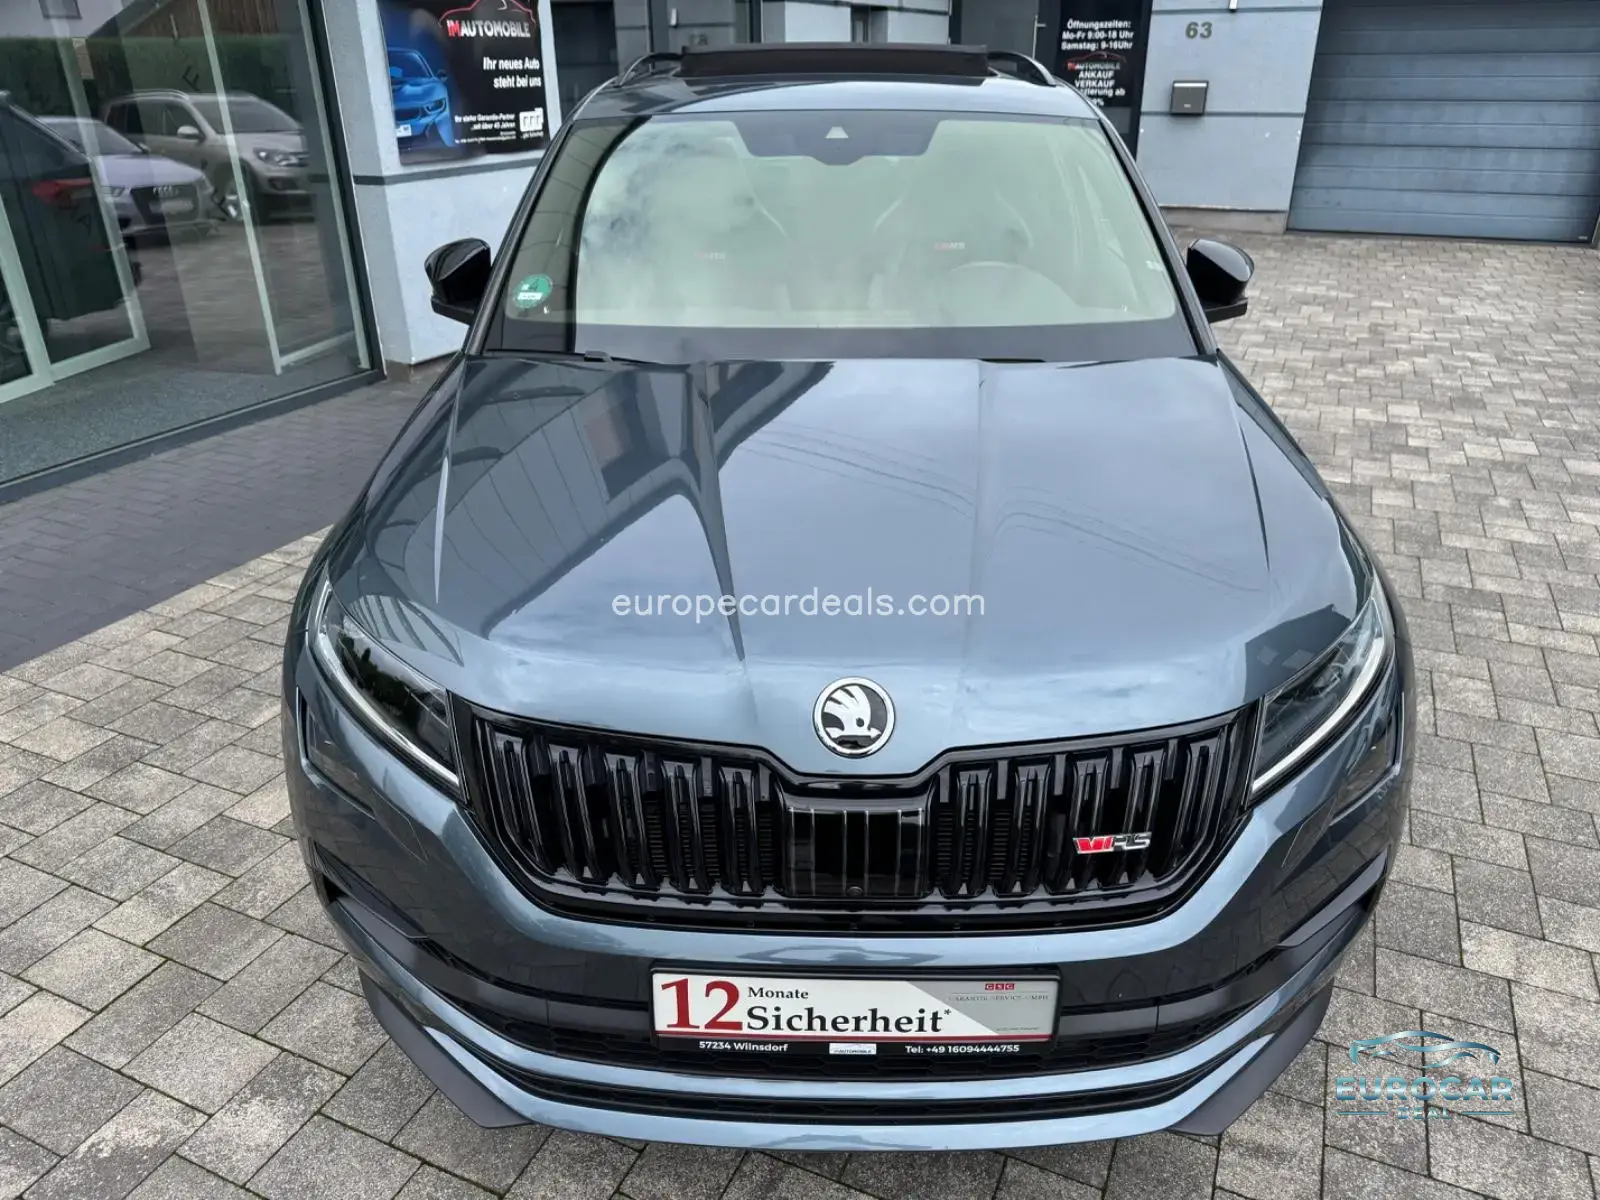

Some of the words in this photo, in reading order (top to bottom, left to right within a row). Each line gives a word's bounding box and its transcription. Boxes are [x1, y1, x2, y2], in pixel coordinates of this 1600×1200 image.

[1067, 18, 1132, 31] Öffnungszeiten:
[1185, 22, 1212, 38] 63
[1062, 30, 1086, 40] Mo-Fr
[1119, 30, 1134, 39] Uhr
[1061, 40, 1099, 51] Samstag:
[483, 57, 497, 70] Ihr
[498, 58, 524, 70] neues
[524, 56, 540, 70] Auto
[1078, 70, 1115, 79] ANKAUF
[494, 75, 515, 88] steht
[516, 74, 528, 88] bei
[529, 76, 542, 87] uns
[1074, 79, 1116, 88] VERKAUF
[1114, 88, 1126, 96] ab
[661, 978, 743, 1031] 12
[747, 986, 810, 1000] Monate
[699, 1041, 731, 1050] 57234
[734, 1042, 788, 1052] Wilnsdorf
[905, 1045, 924, 1054] Tel:
[926, 1044, 946, 1054] +49
[948, 1044, 1020, 1054] 16094444755
